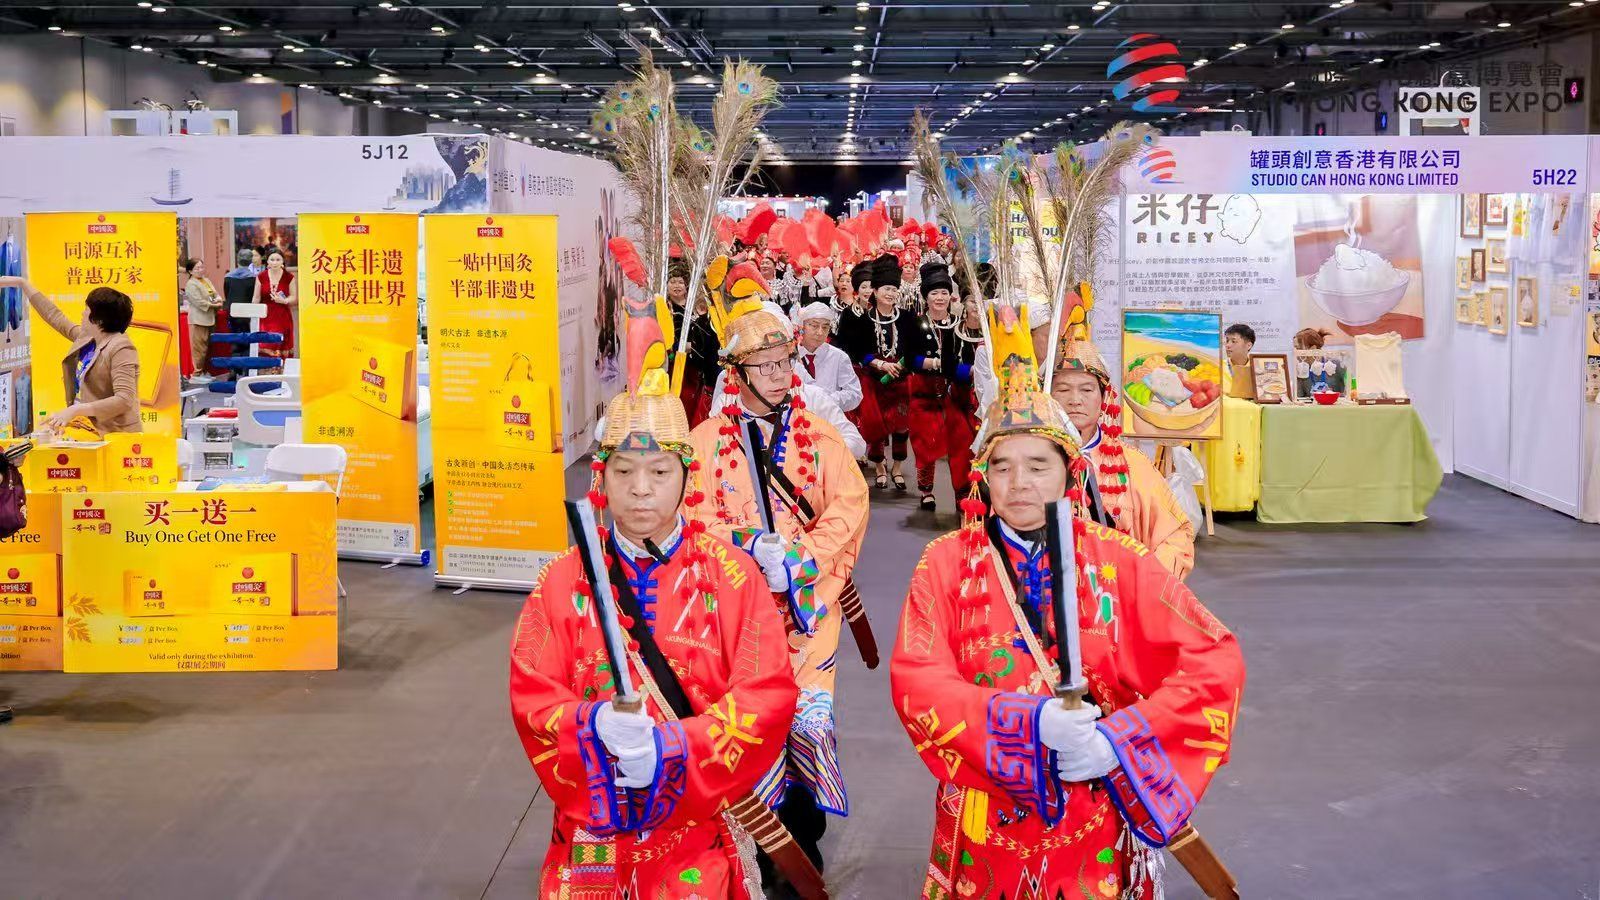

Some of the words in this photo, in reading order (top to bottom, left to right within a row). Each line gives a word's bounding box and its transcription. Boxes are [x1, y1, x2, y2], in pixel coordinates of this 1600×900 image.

[362, 144, 409, 160] 5J12
[1250, 150, 1461, 169] 罐頭創意香港有限公司
[1251, 173, 1298, 187] STUDIO
[1301, 173, 1326, 187] CAN
[1330, 173, 1366, 187] HONG
[1369, 173, 1404, 187] KONG
[1408, 172, 1459, 187] LIMITED
[1533, 168, 1577, 186] 5H22
[1132, 193, 1219, 226] 米仔
[1136, 232, 1214, 244] RICEY
[64, 240, 142, 260] 同源互补
[311, 248, 403, 276] 灸承非遗
[447, 252, 533, 273] 一贴中国灸
[67, 265, 143, 285] 普惠万家
[314, 279, 407, 307] 贴暖世界
[450, 278, 536, 300] 半部非遗史
[143, 498, 257, 527] 买一送一
[11, 533, 41, 543] Free
[125, 530, 152, 547] Buy
[155, 530, 184, 543] One
[187, 530, 211, 543] Get
[214, 530, 243, 543] One
[246, 529, 277, 543] Free
[183, 653, 206, 661] during
